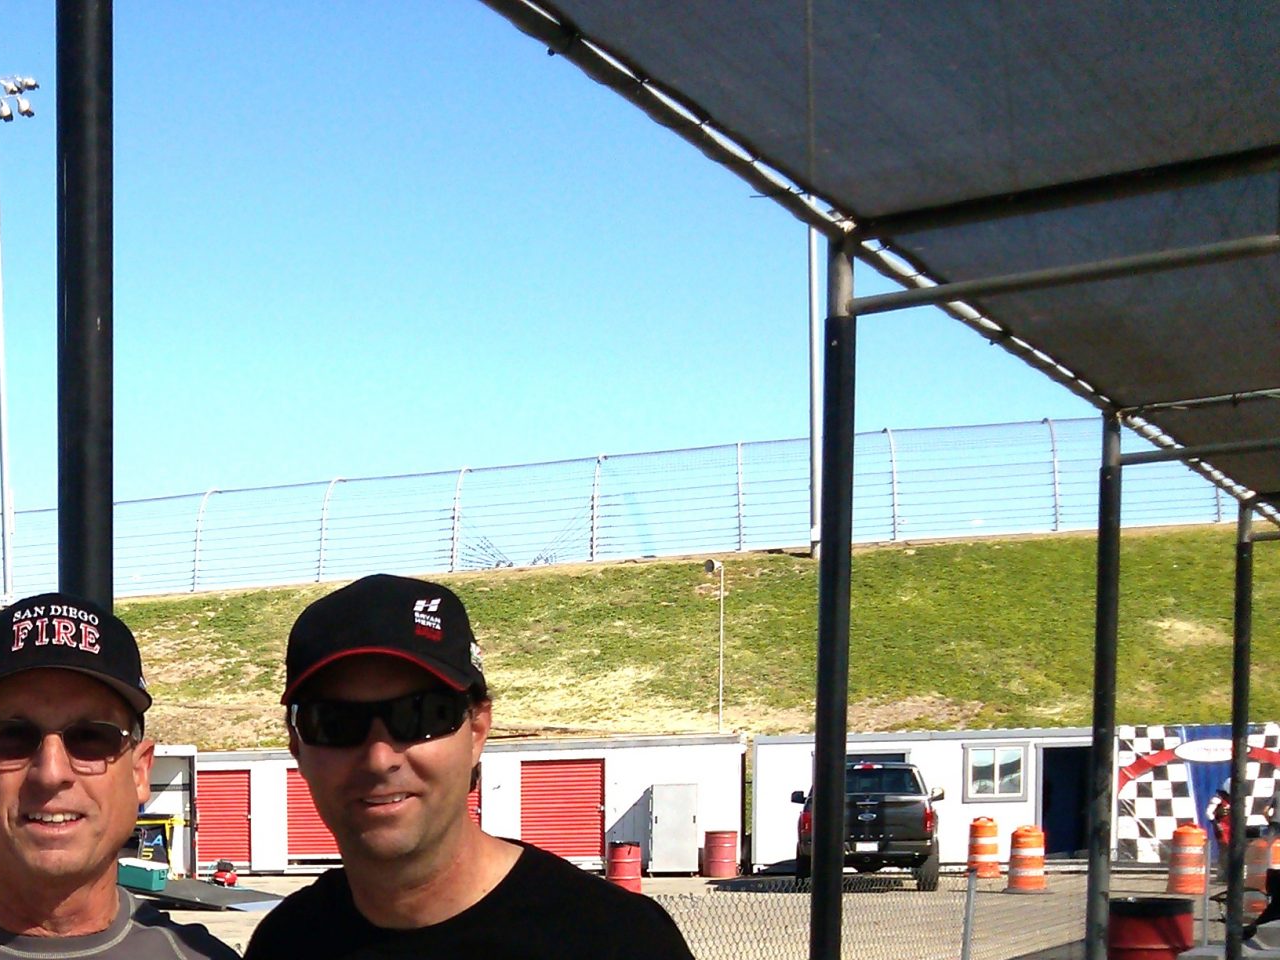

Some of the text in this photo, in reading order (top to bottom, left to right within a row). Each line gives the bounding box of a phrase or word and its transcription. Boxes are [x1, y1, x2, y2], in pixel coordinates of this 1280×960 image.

[12, 604, 99, 626] SAN DIEGO
[11, 617, 101, 654] FIRE
